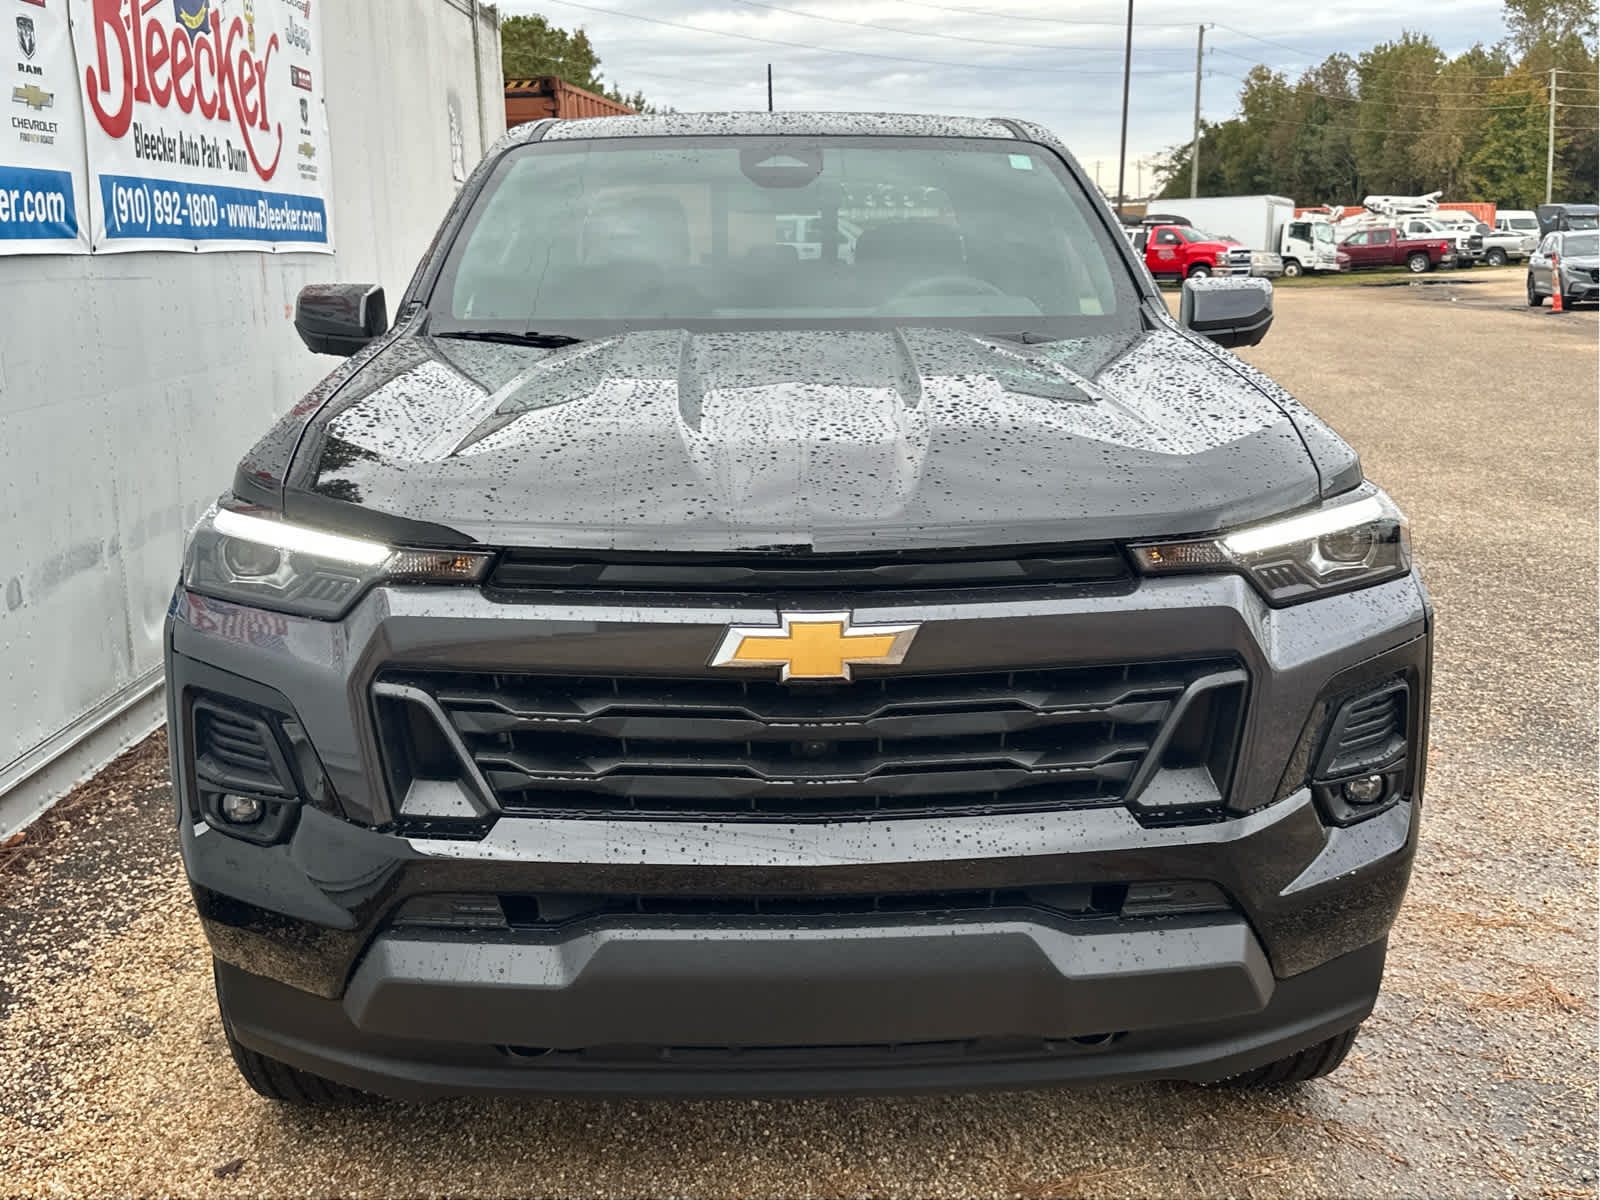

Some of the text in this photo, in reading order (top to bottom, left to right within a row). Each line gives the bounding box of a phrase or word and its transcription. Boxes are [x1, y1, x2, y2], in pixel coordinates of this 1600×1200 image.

[17, 62, 42, 75] RAM
[11, 116, 57, 132] CHEVROLET
[133, 122, 176, 163] Bleecker
[179, 130, 200, 167] Auto
[200, 134, 221, 168] Park
[226, 139, 248, 172] Dunn
[0, 188, 65, 222] er.com
[112, 182, 151, 232] (910)
[153, 189, 218, 227] 892-1800
[227, 200, 323, 233] www.Bleecker.com
